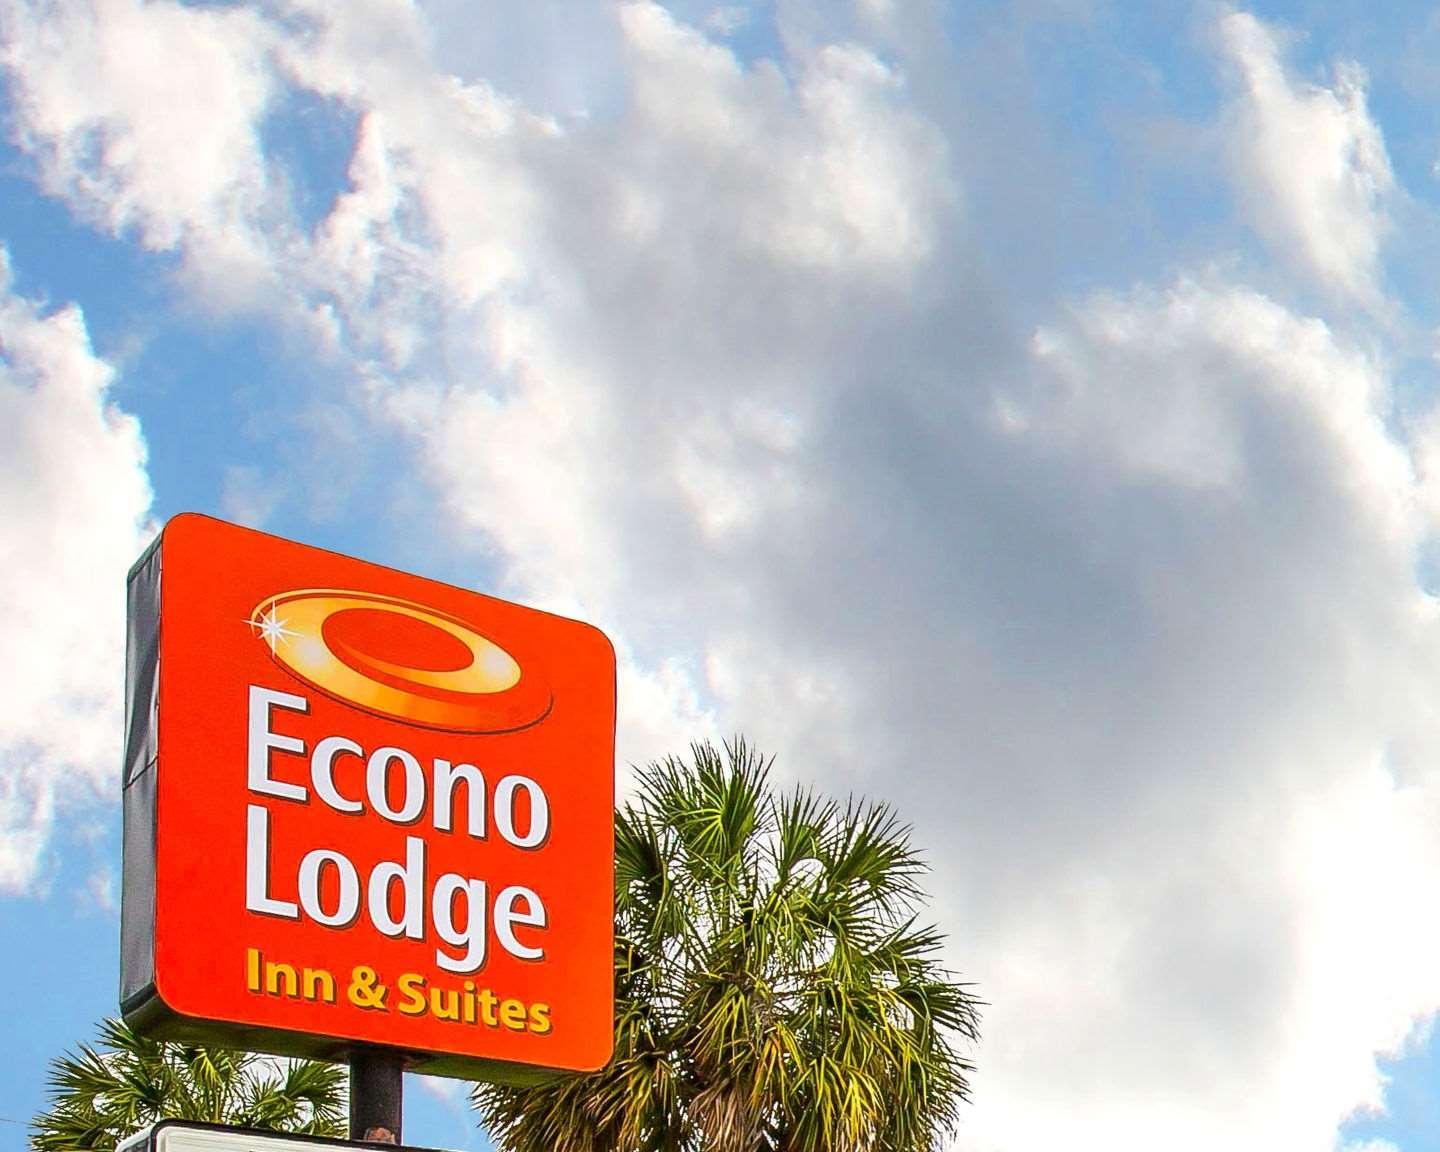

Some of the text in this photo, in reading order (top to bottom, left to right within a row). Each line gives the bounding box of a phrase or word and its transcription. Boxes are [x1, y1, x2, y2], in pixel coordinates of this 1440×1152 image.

[247, 684, 550, 850] Econo
[246, 804, 547, 975] Lodge
[247, 948, 553, 1034] Inn & Suites
